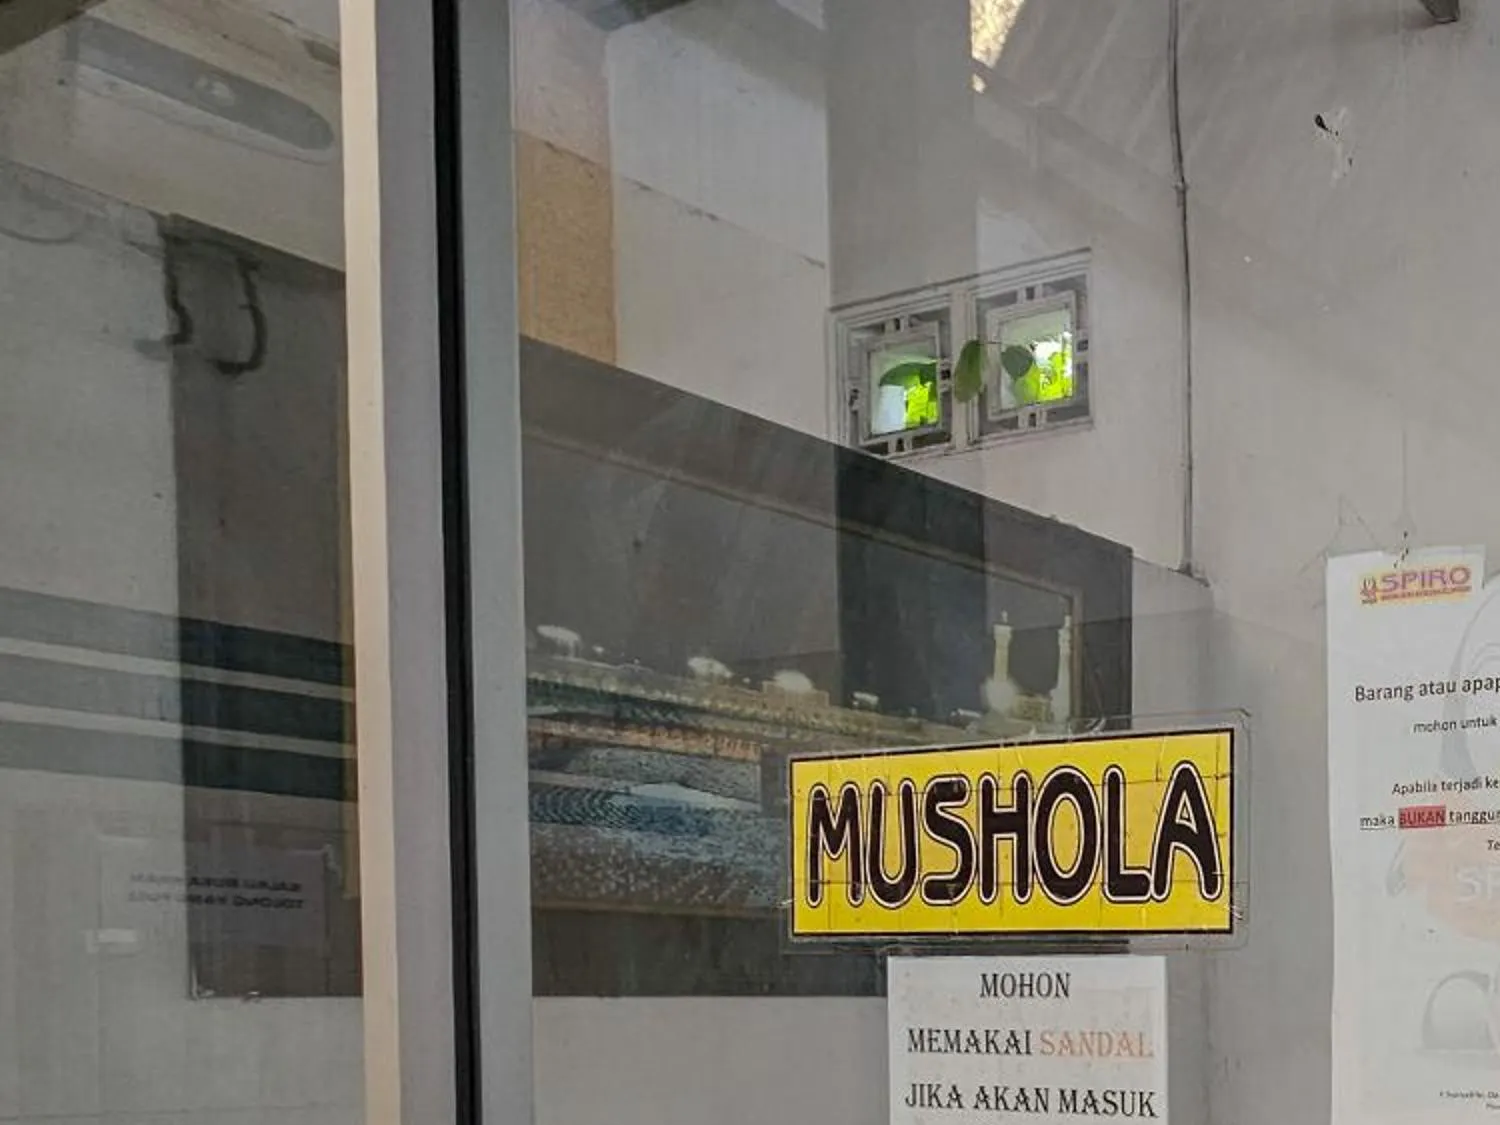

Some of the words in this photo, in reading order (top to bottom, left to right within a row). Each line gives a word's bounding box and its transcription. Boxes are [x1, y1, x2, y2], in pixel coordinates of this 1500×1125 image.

[1381, 567, 1471, 593] SPIRO
[1355, 681, 1414, 702] Barang
[1418, 680, 1457, 697] atau
[1413, 717, 1457, 733] mohon
[1460, 715, 1498, 730] untuk
[1392, 778, 1438, 796] Apabila
[1441, 776, 1482, 793] terjadi
[1360, 813, 1395, 828] maka
[1400, 809, 1445, 827] BUKAN
[806, 760, 1222, 909] MUSHOLA
[980, 972, 1071, 1000] MOHON
[907, 1028, 1032, 1056] MEMAKAI
[1039, 1031, 1154, 1059] SANDAL
[904, 1082, 964, 1111] JIKA
[974, 1084, 1051, 1115] AKAN
[1058, 1089, 1159, 1119] MASUK
